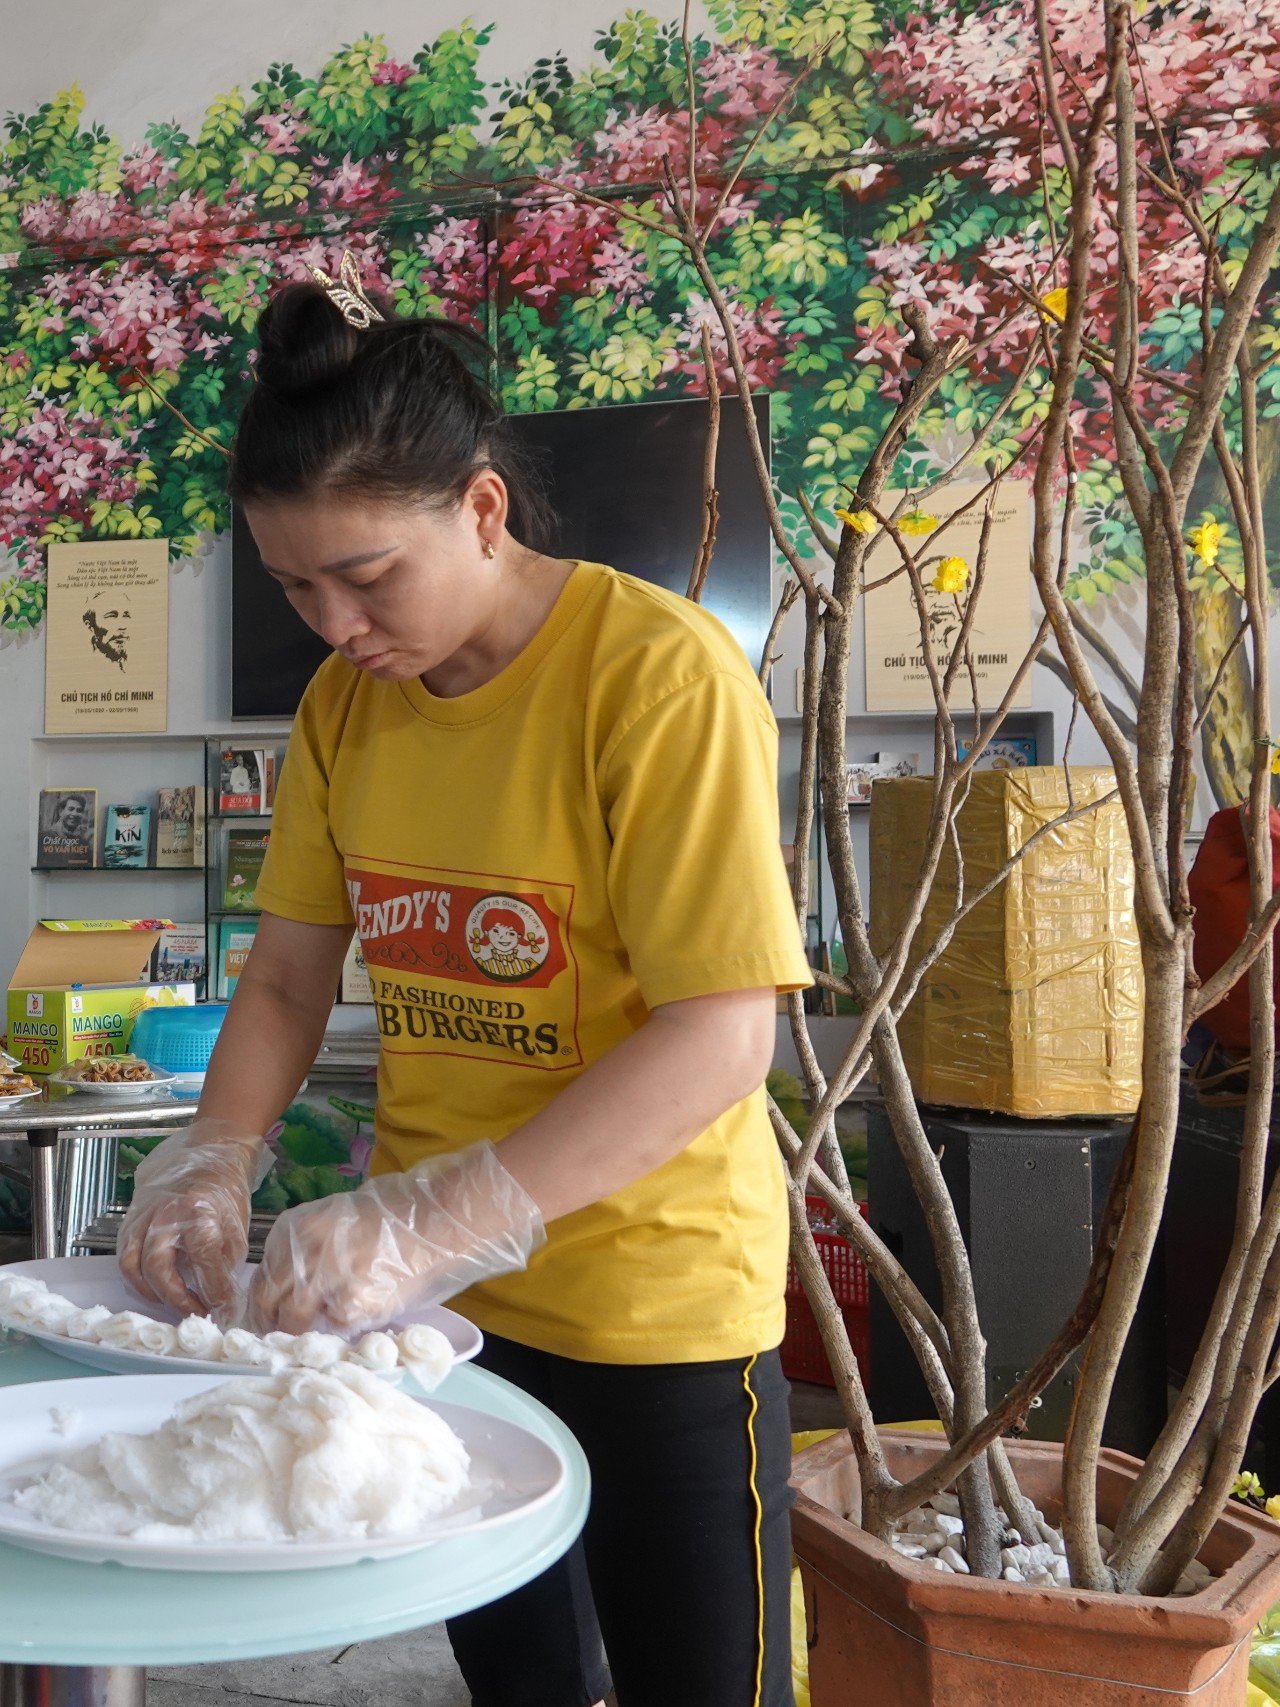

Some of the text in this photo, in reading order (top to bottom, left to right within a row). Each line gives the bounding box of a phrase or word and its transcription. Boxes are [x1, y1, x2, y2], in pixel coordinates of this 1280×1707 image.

[909, 656, 926, 669] TỊC
[978, 653, 1008, 665] MINH
[80, 692, 99, 704] TỊCH
[114, 689, 129, 701] CHÍ
[131, 691, 154, 701] MINH
[346, 878, 452, 941] WENDY'S
[501, 900, 518, 910] OUR
[380, 981, 525, 1020] FASHIONED
[13, 1021, 58, 1037] MANGO
[72, 1013, 123, 1033] MANGO
[22, 1045, 50, 1067] 450
